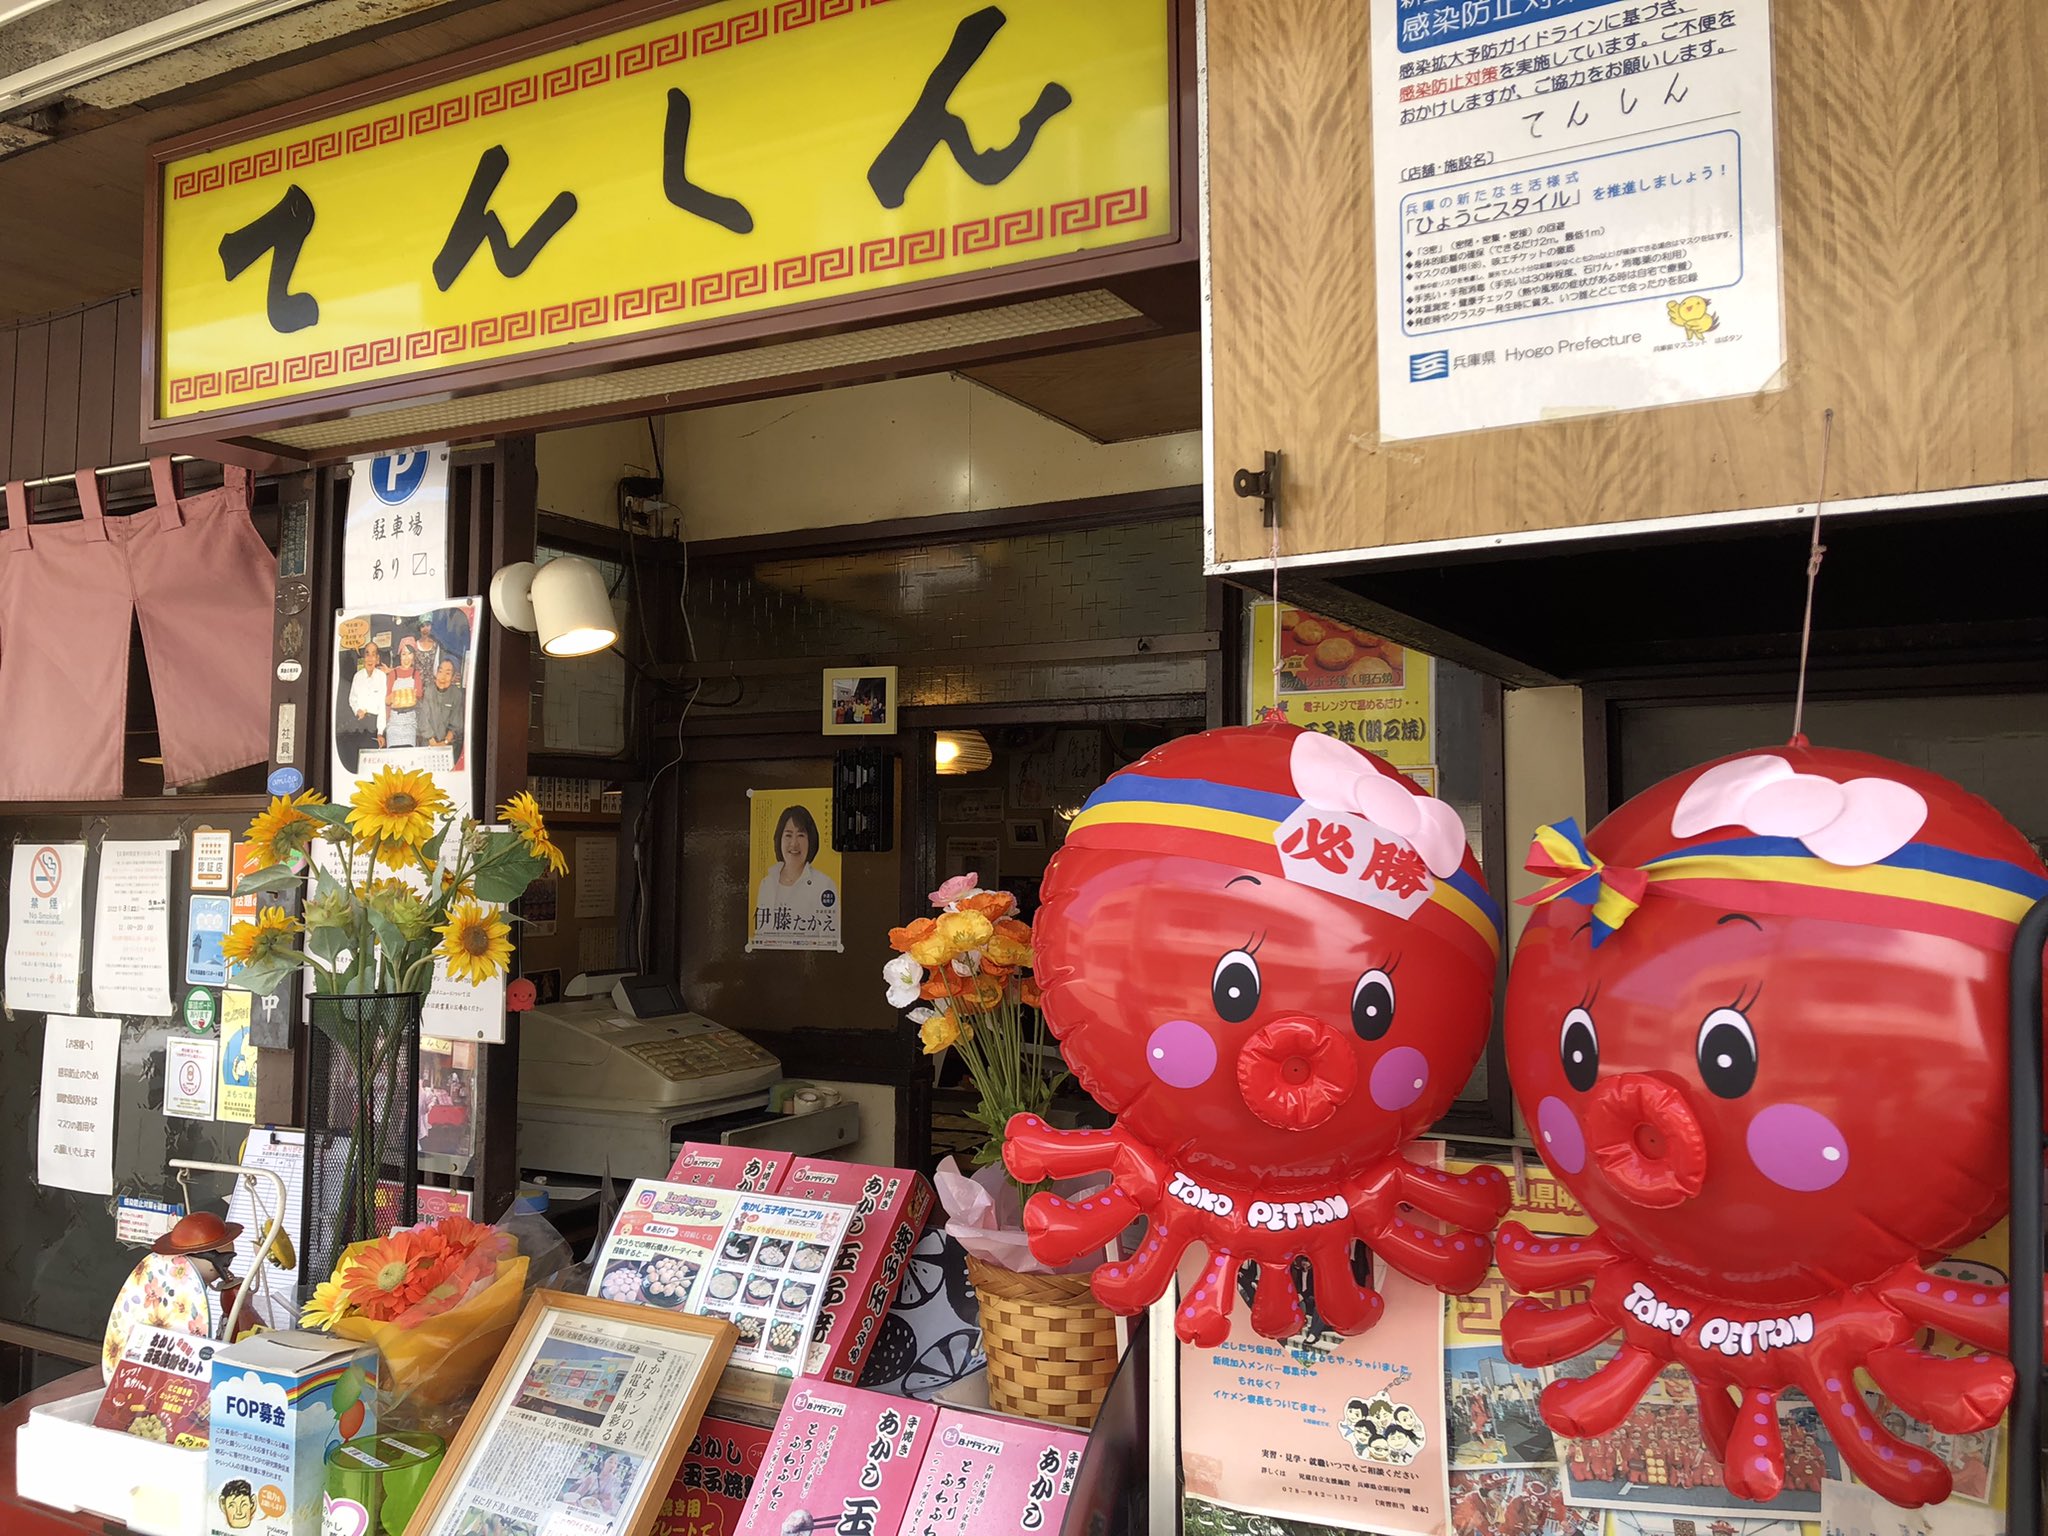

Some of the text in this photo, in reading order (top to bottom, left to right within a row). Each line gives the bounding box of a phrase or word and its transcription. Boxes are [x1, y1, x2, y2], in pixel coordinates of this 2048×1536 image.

[1399, 2, 1686, 80] 感染拡大予防ガイドラインに基づき、
[1399, 10, 1736, 102] 感染防止対策を実施しています。ご不便を
[1399, 38, 1727, 125] おかけしますが、ご協力をお願いします。
[218, 5, 1072, 335] てんしん
[1405, 170, 1580, 216] 兵庫の新たな生活様式
[1406, 189, 1582, 236] 「ひょうごスタイル」
[1453, 331, 1642, 370] 兵庫県 Hyogo Prefecture
[372, 512, 423, 541] 駐車場
[1281, 818, 1428, 899] 必勝
[753, 907, 836, 932] 伊藤たかえ
[226, 1395, 286, 1428] FOP募金
[898, 1416, 919, 1457] 手焼き
[1061, 1451, 1080, 1495] 手焼き
